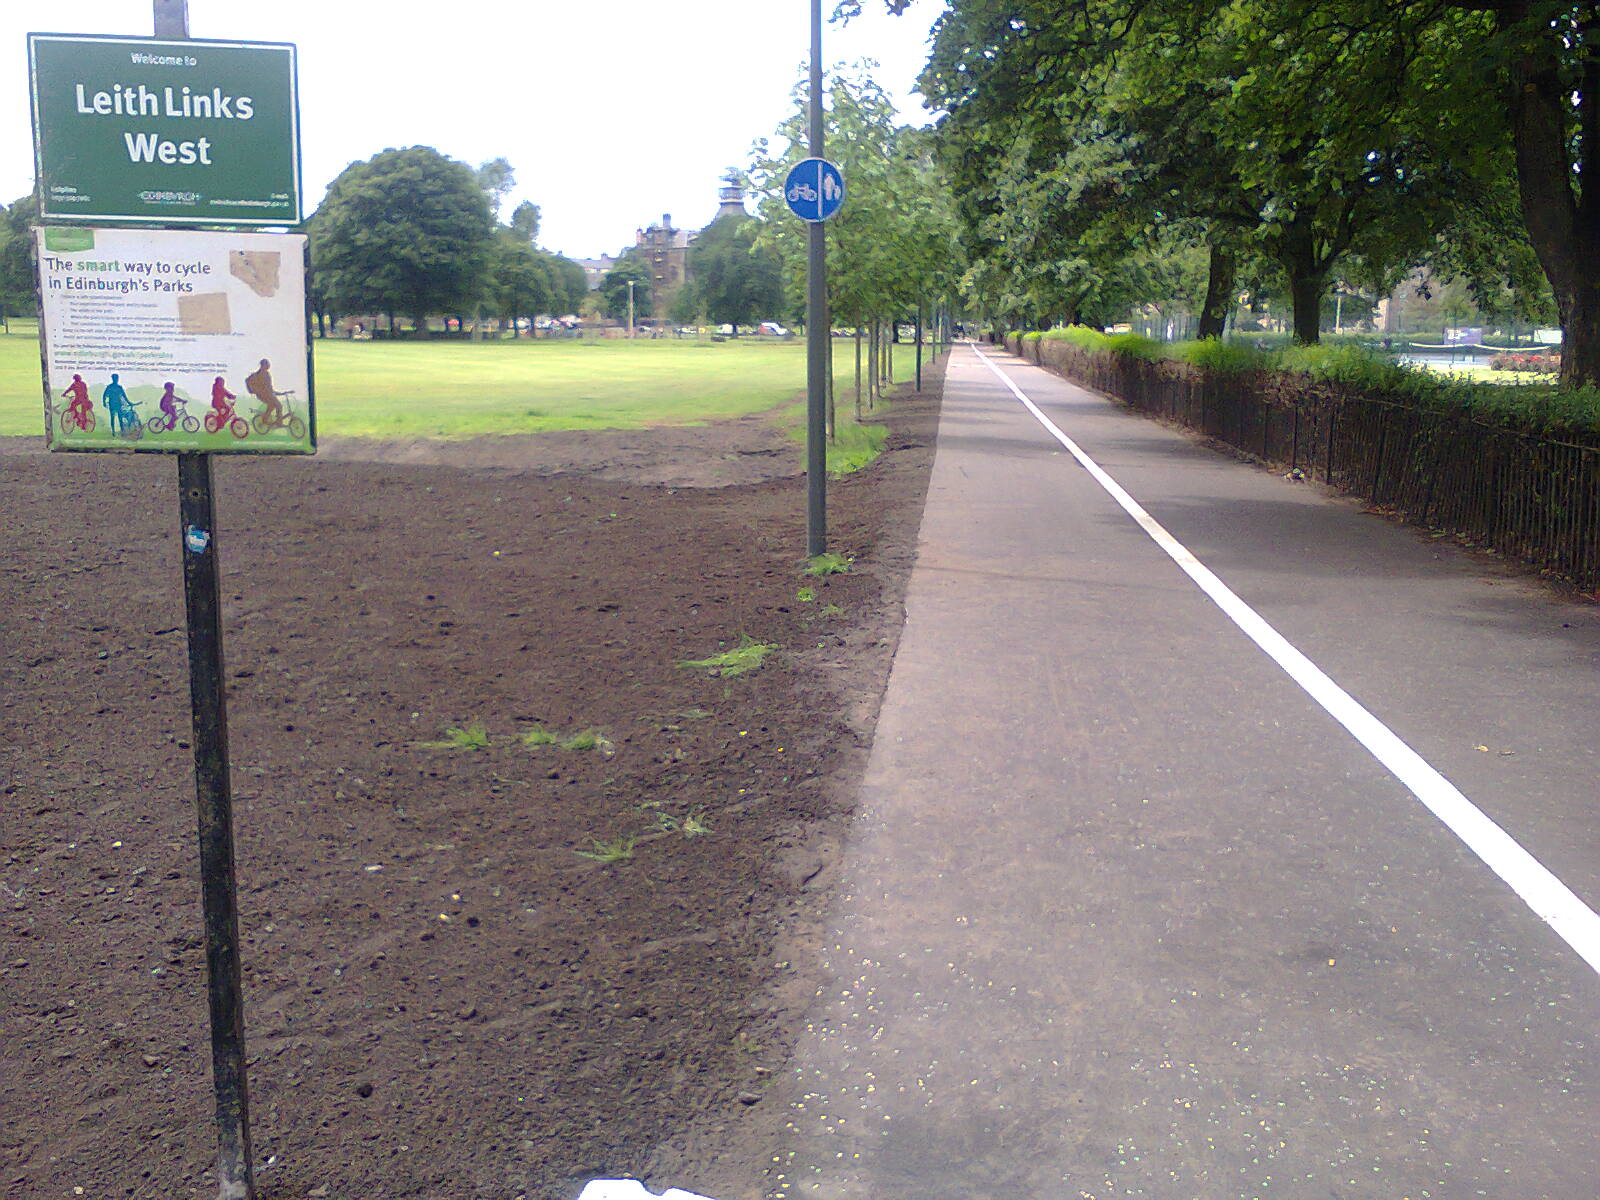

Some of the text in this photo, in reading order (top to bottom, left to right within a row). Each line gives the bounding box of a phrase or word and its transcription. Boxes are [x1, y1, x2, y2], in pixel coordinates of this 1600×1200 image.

[130, 53, 197, 66] Welcome to
[76, 84, 254, 120] Leith Links
[124, 132, 212, 165] West
[44, 257, 211, 277] The smart way to cycle
[48, 276, 194, 293] in Edinburgh's Parks
